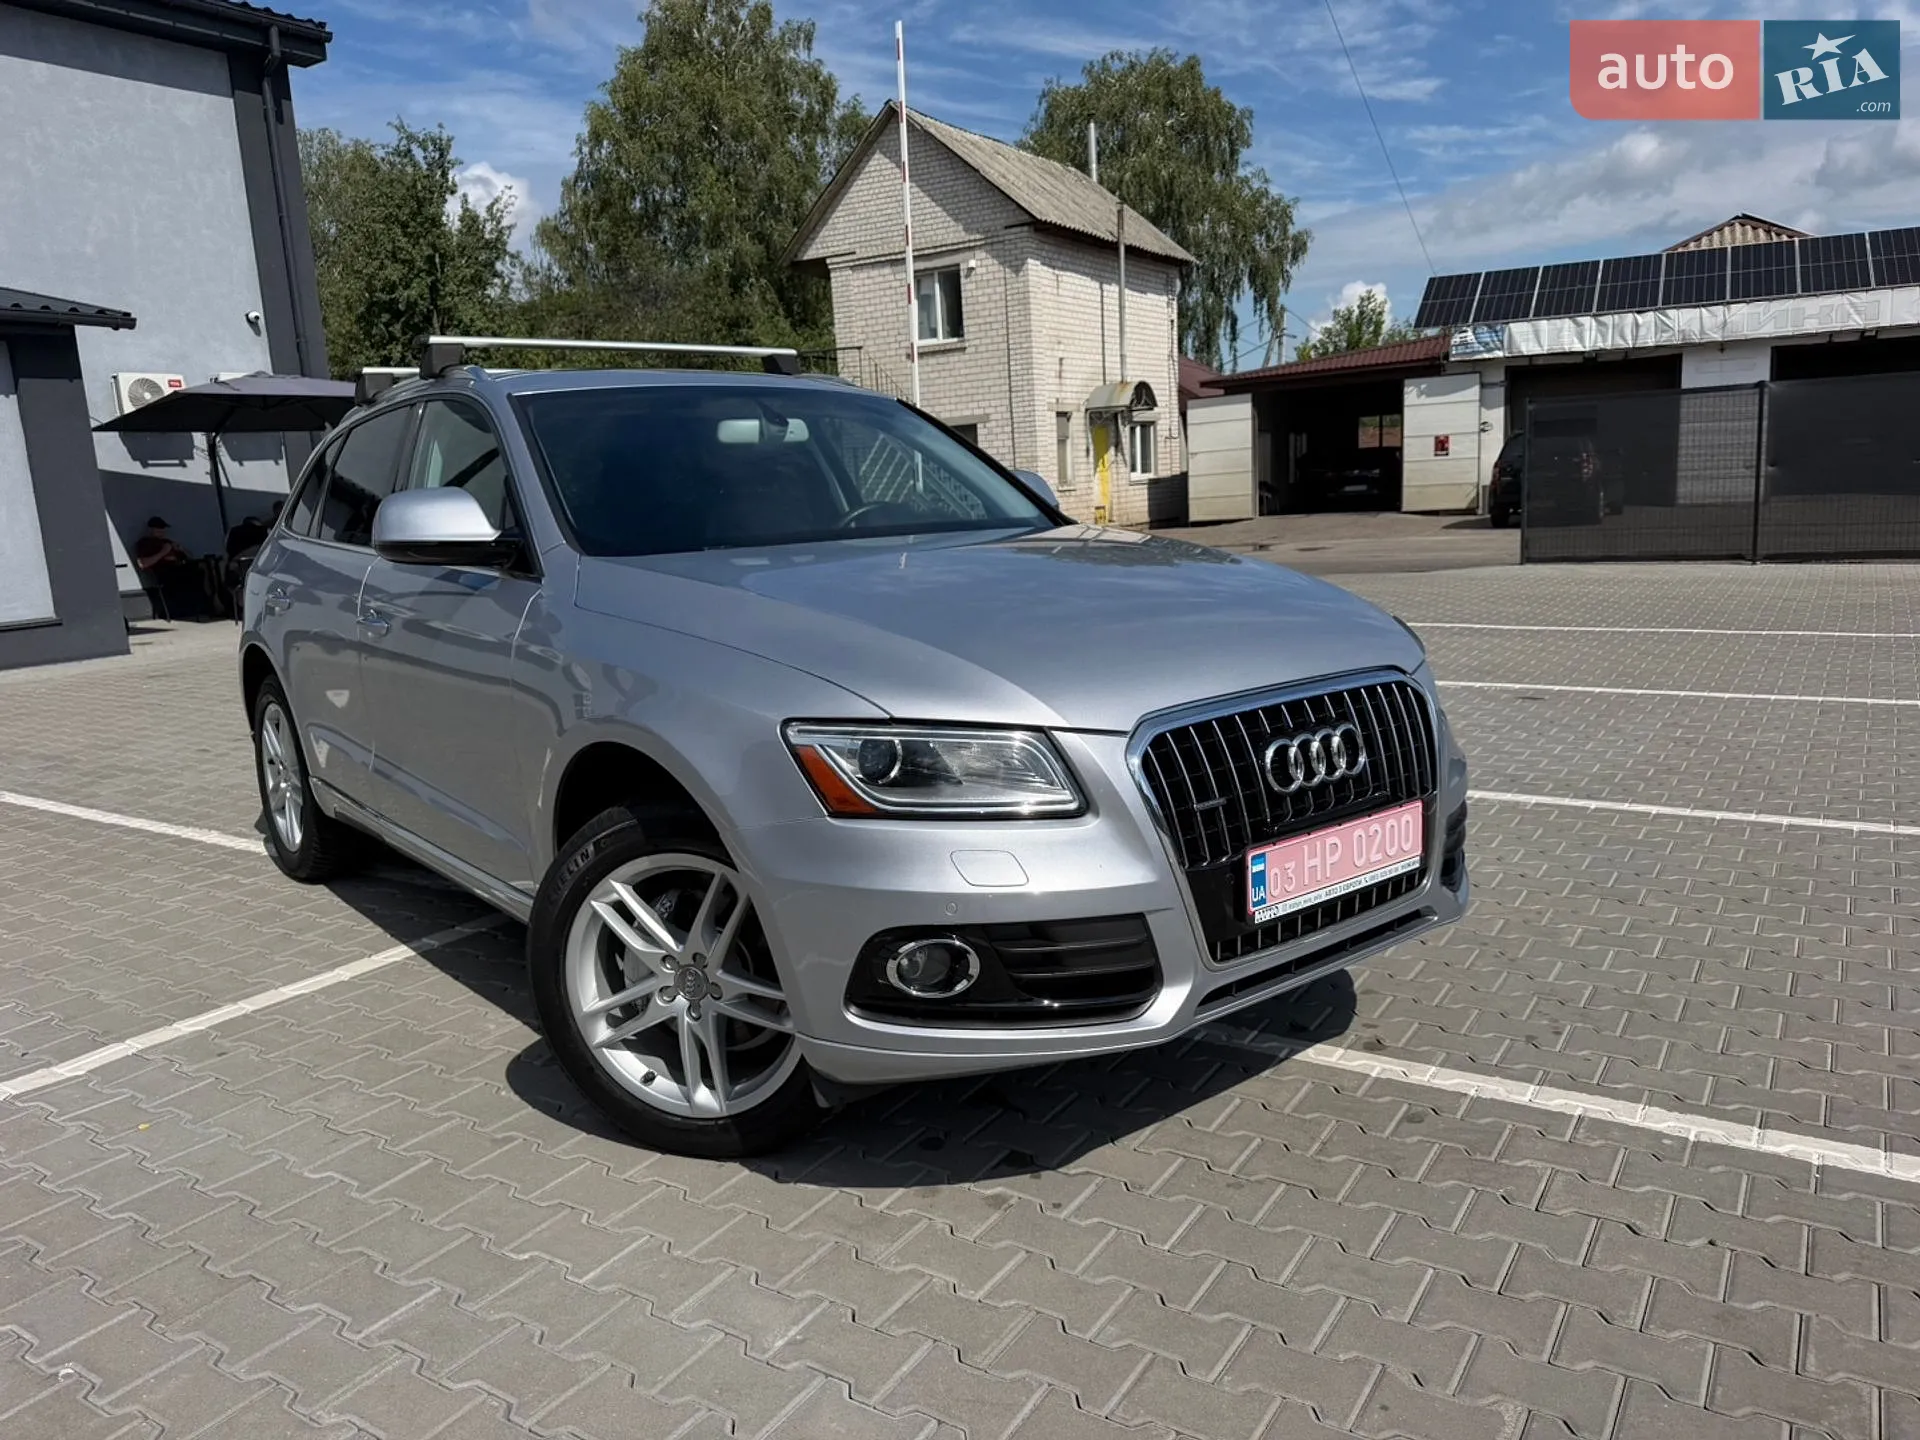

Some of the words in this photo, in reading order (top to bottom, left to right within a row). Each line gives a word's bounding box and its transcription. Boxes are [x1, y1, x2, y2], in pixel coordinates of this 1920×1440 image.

[1269, 859, 1296, 898] 03
[1302, 835, 1343, 887] HP
[1352, 813, 1414, 869] 0200
[1252, 885, 1266, 902] UA
